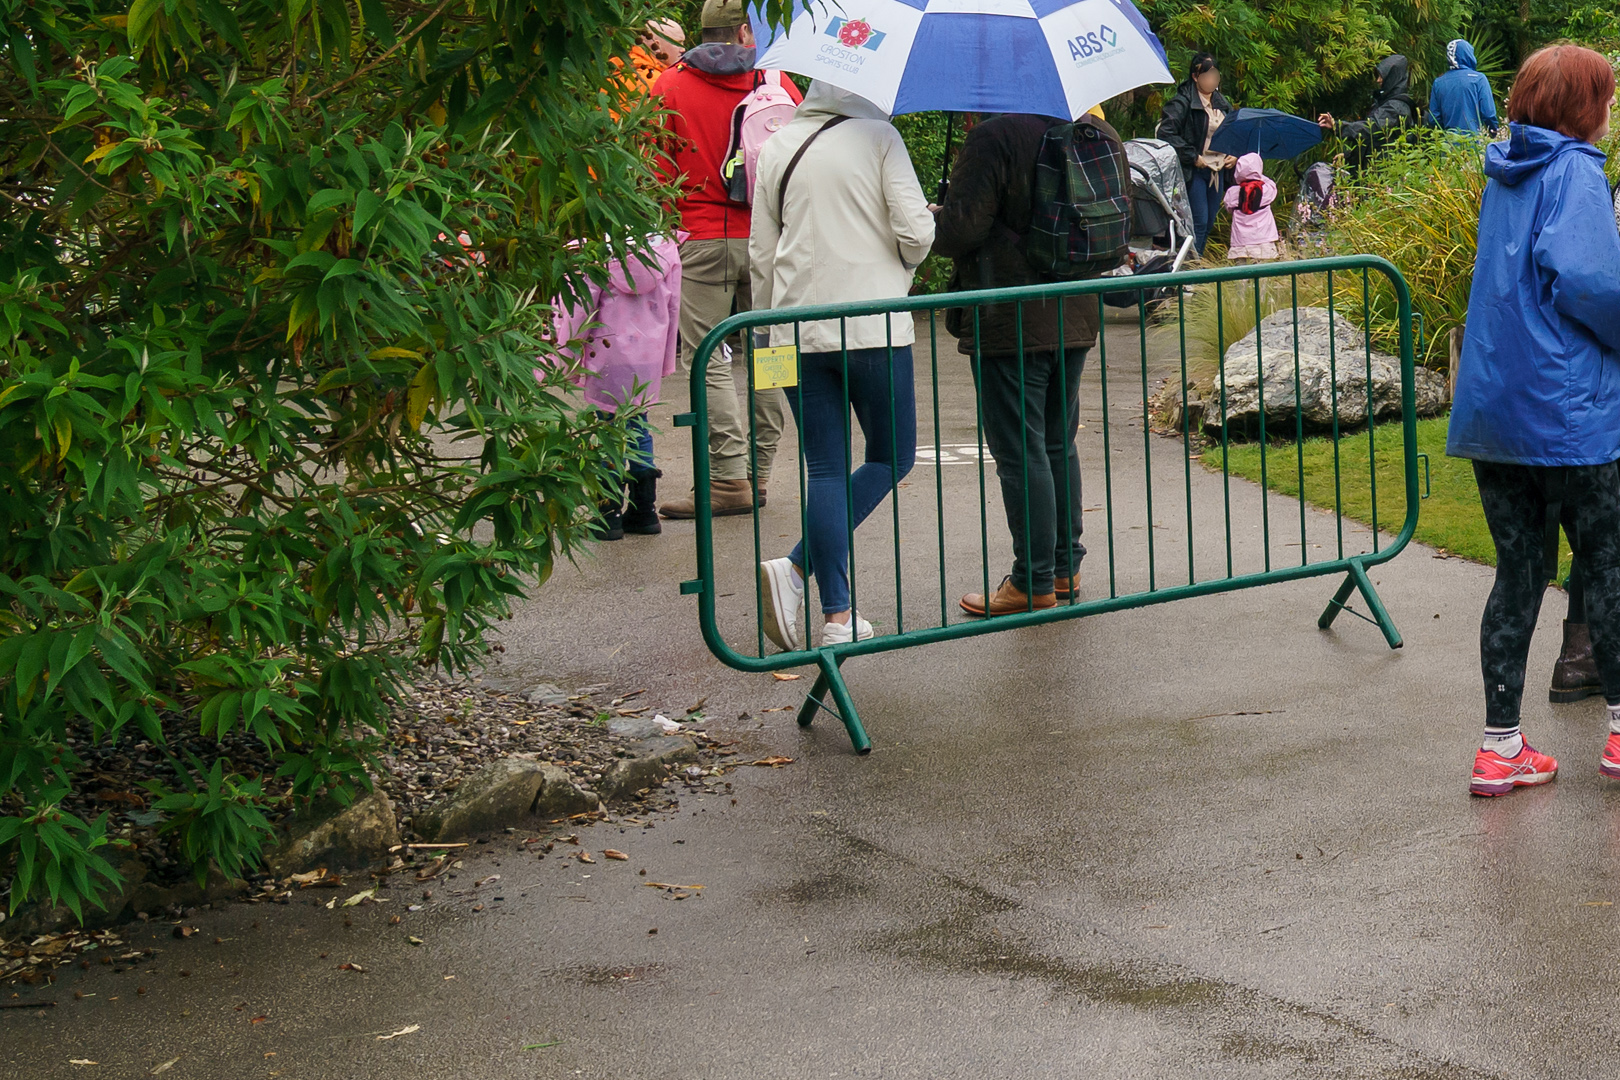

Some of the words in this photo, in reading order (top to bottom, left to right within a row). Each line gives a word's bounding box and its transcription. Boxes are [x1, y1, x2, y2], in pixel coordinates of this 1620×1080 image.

[820, 43, 866, 66] CROSTON
[1067, 31, 1103, 61] ABS
[815, 53, 842, 69] SPORTS
[842, 63, 860, 75] CLUB
[756, 354, 785, 364] PROPERTY
[786, 353, 794, 361] OF
